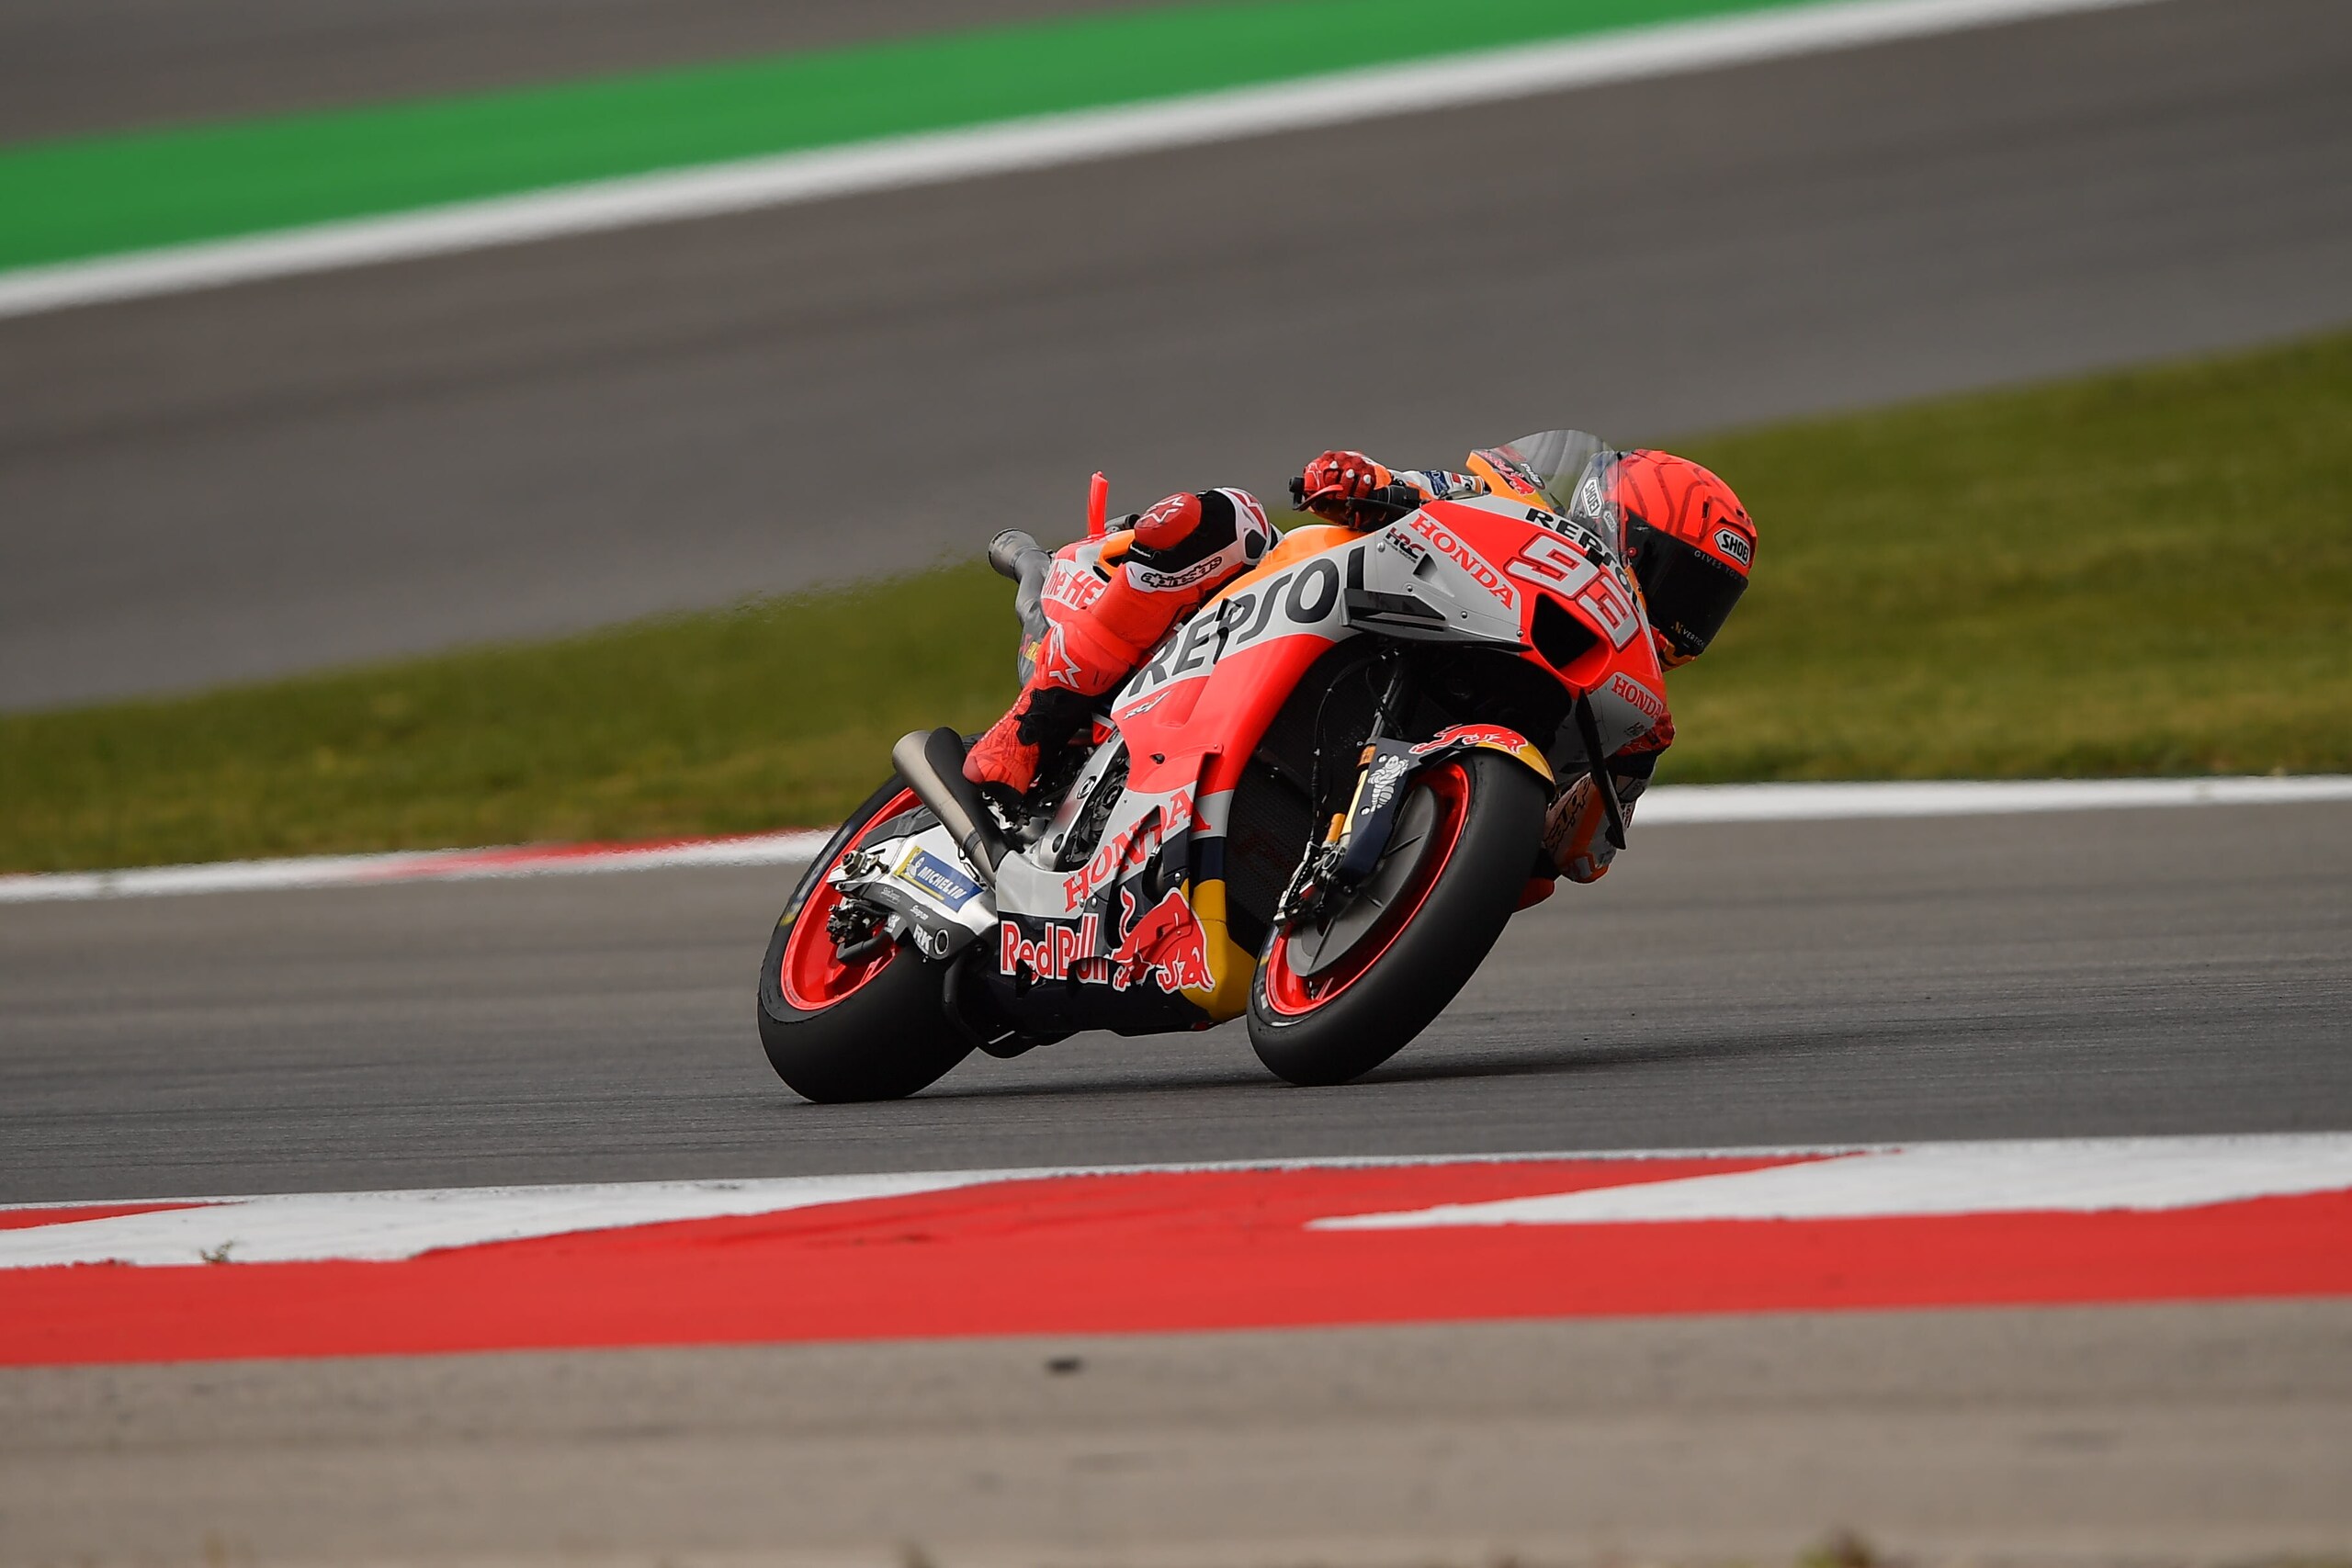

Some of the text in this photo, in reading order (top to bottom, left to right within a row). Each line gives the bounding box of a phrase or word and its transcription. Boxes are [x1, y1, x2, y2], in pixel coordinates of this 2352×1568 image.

[1585, 481, 1600, 514] SHOEI
[1385, 526, 1426, 559] HRC
[1693, 549, 1722, 570] GIVES
[1140, 556, 1223, 588] alpinestars
[1409, 513, 1514, 610] HONDA
[1506, 532, 1641, 653] 93
[1611, 674, 1664, 721] HONDA
[1063, 789, 1211, 912] HONDA
[917, 865, 967, 900] MICHELIN
[913, 923, 933, 950] RK
[1001, 912, 1109, 985] Red Bull
